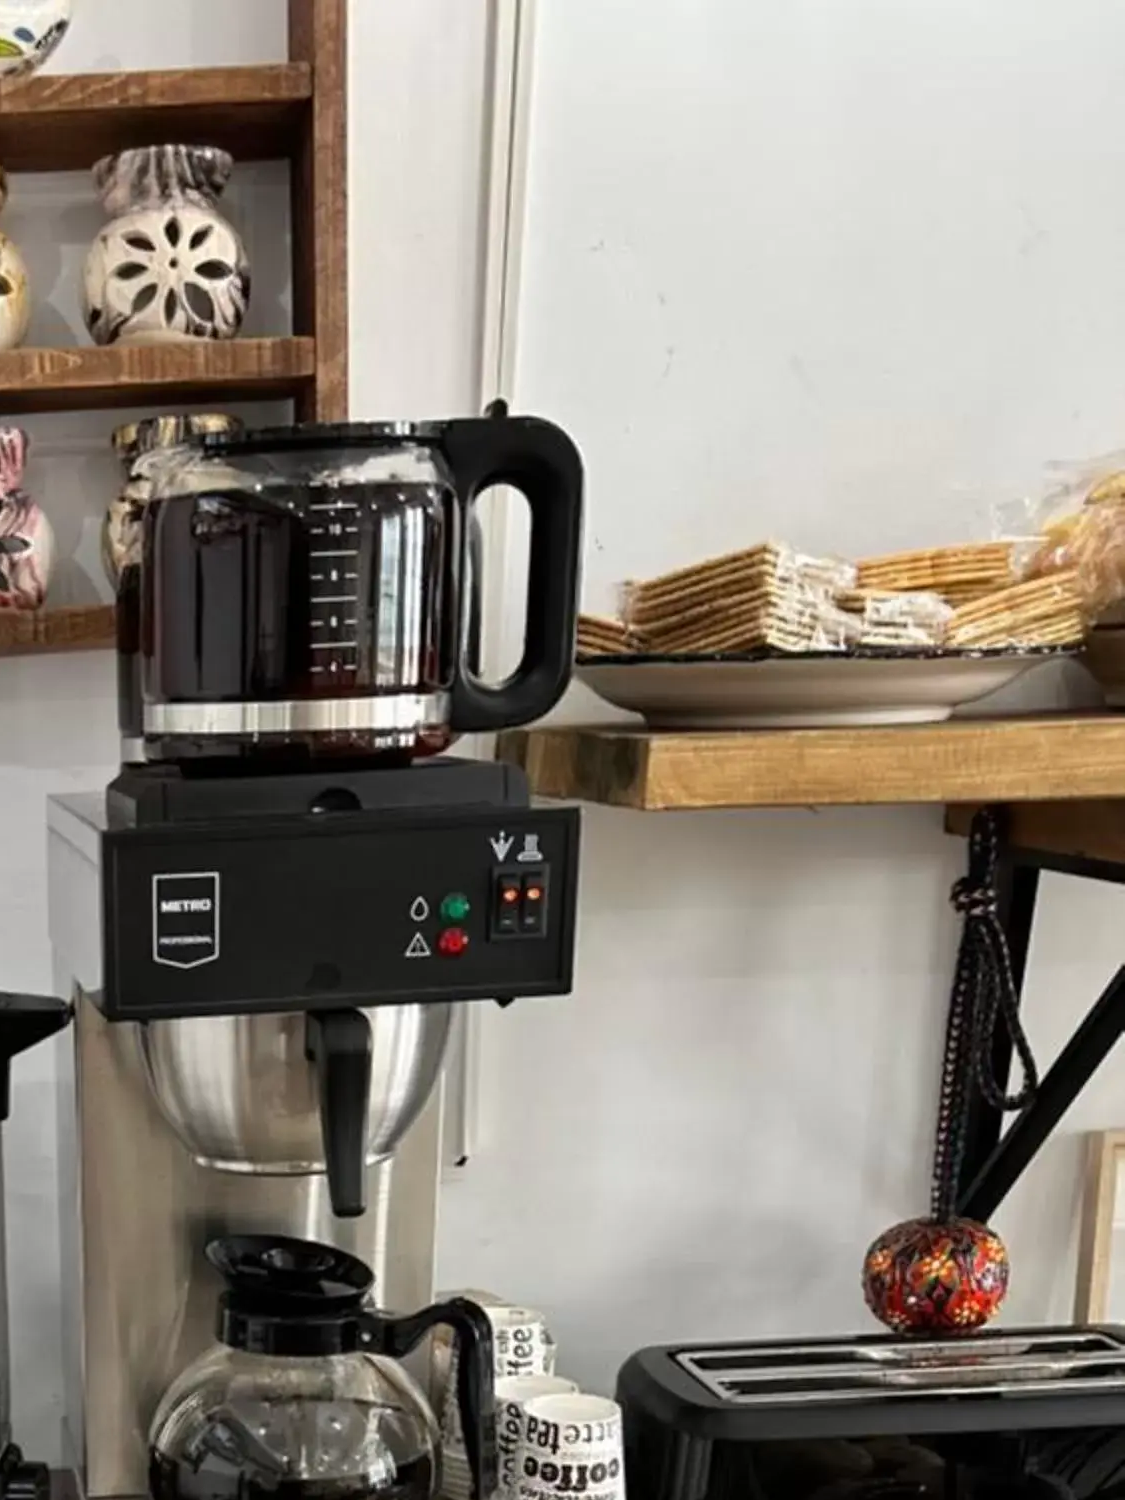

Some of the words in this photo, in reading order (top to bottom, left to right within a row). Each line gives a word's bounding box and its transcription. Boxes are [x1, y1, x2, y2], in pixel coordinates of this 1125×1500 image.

[160, 898, 212, 913] METRO
[526, 1414, 560, 1455] tea
[523, 1456, 620, 1493] coffee
